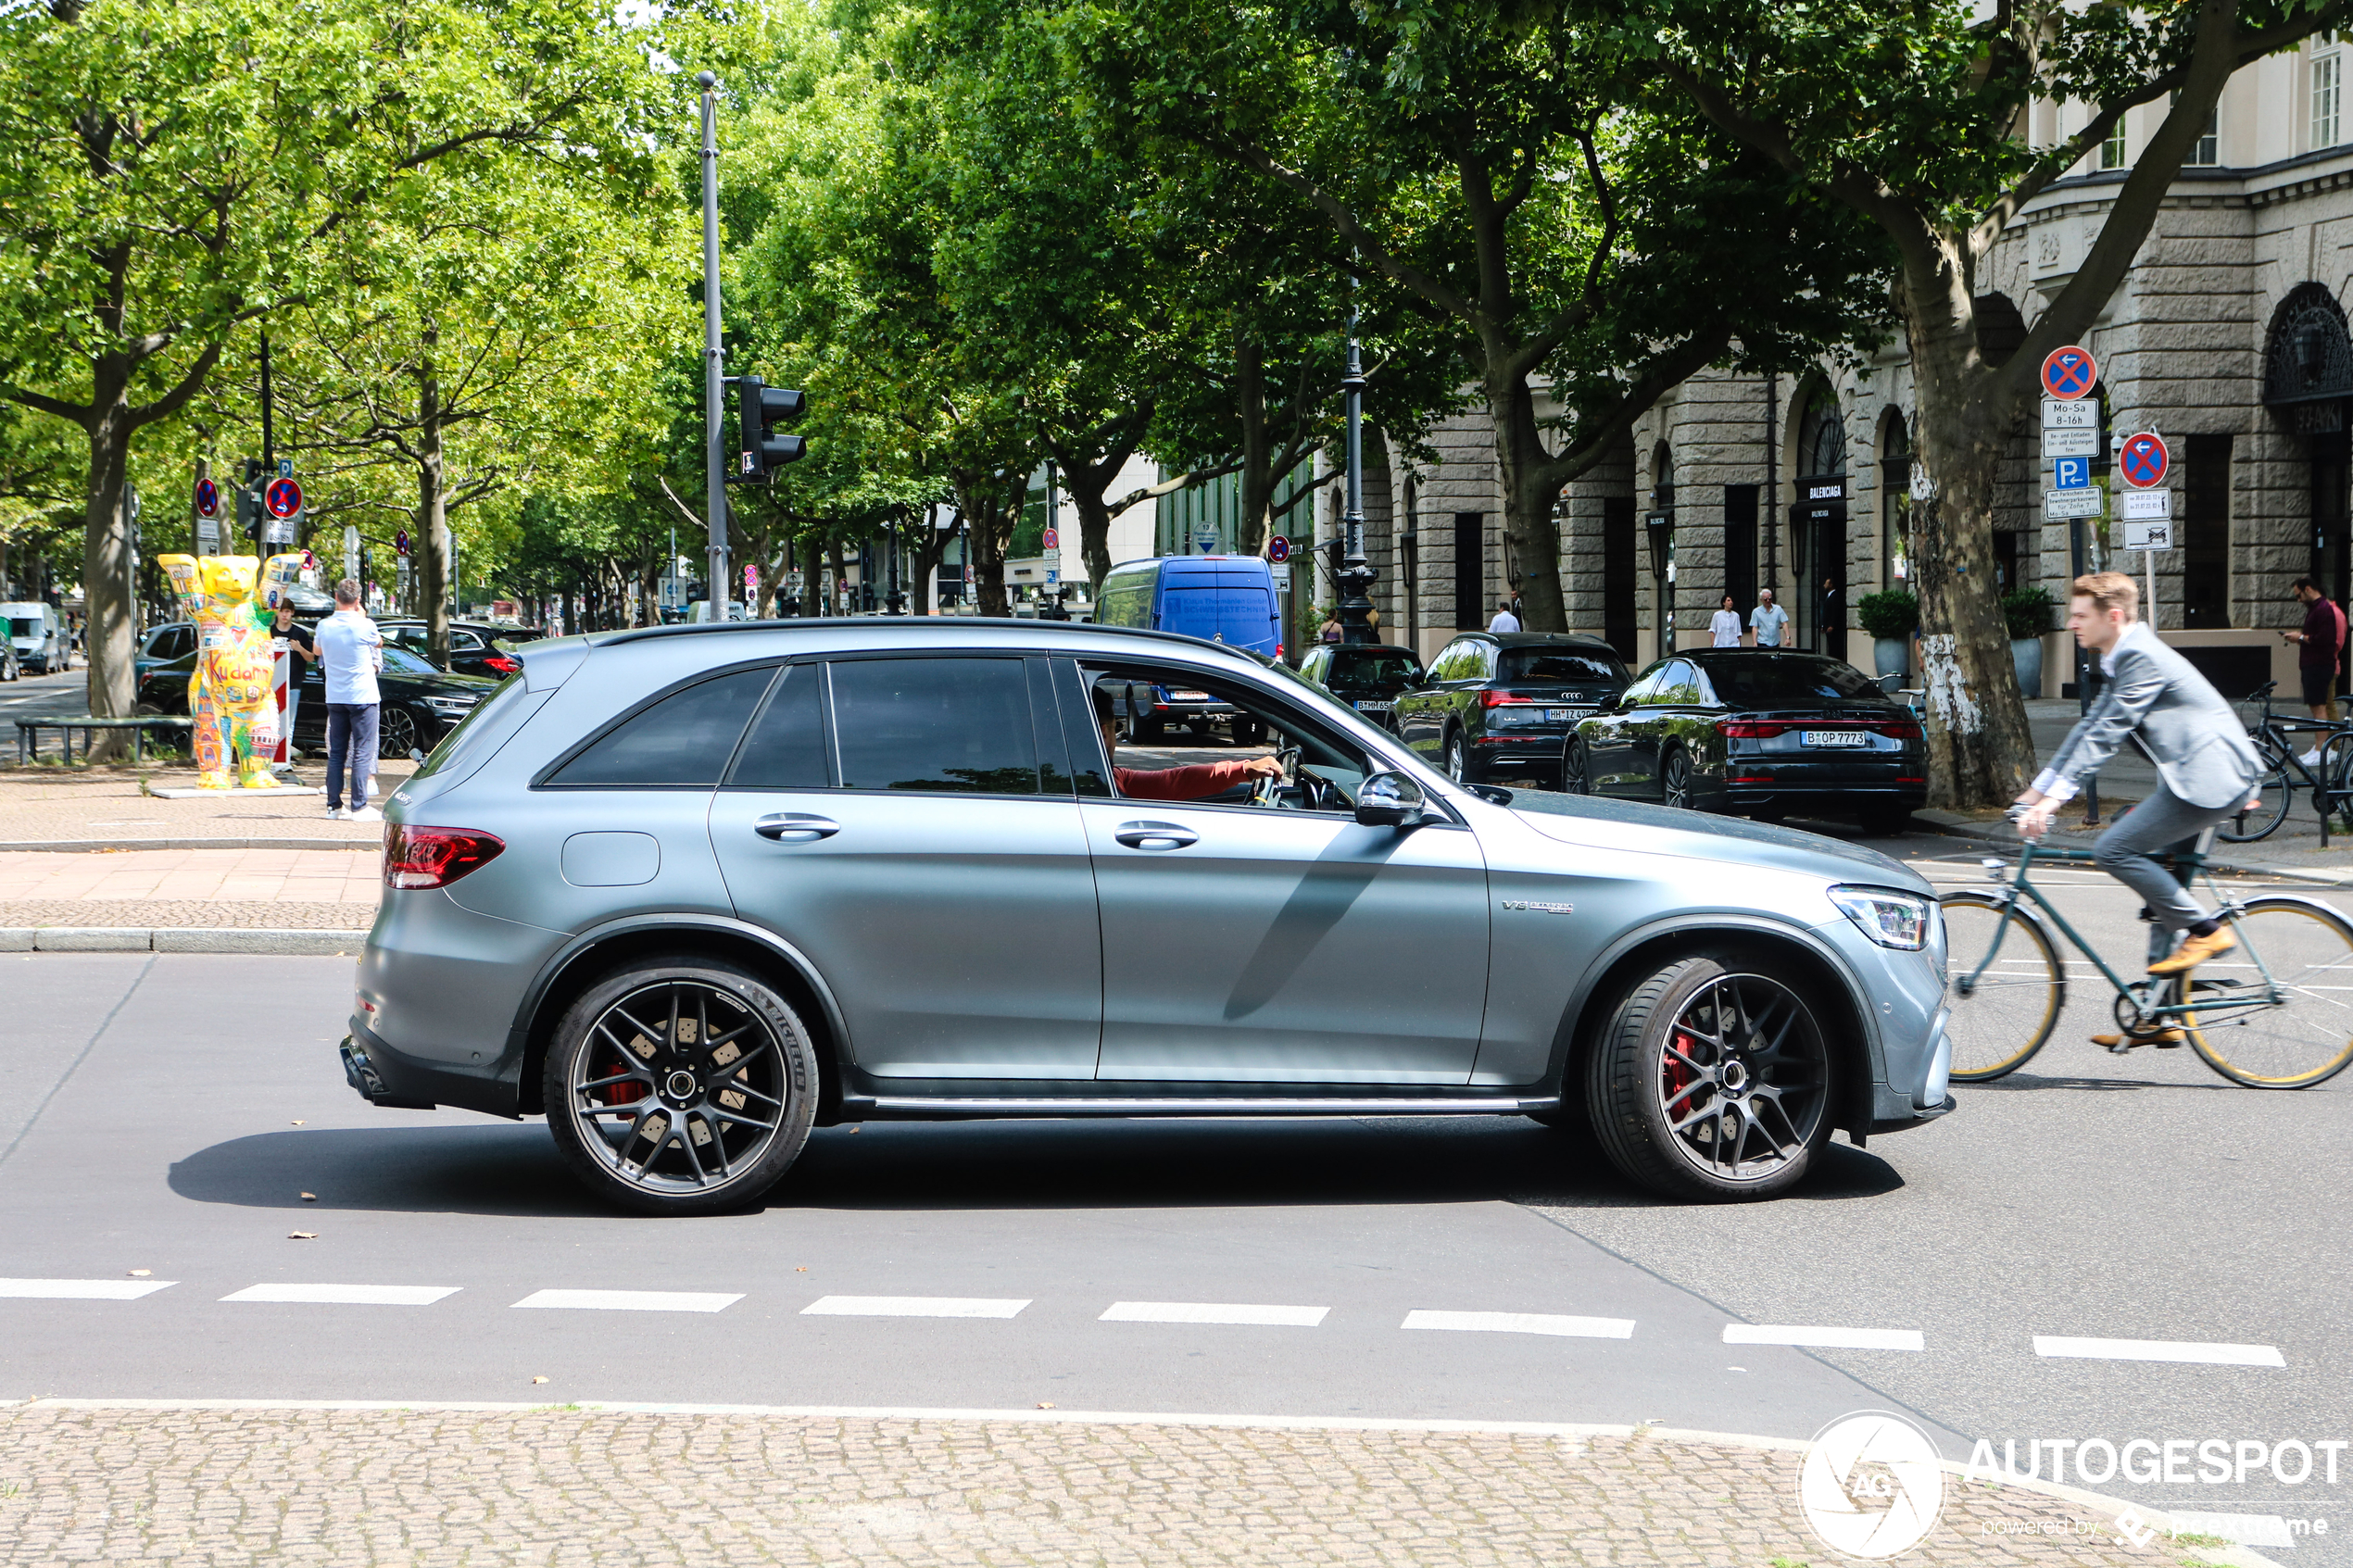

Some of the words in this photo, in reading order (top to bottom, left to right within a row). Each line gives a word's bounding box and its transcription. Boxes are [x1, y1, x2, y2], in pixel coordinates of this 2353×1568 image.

[2054, 404, 2086, 413] Mo-Sa
[2057, 416, 2082, 425] 8-16h
[2060, 460, 2078, 486] P
[1809, 484, 1842, 500] BALENCIAGA
[1811, 509, 1830, 518] BALENCIAGA
[1358, 701, 1364, 709] B
[1550, 709, 1561, 721] HH
[1566, 709, 1576, 721] IZ
[1807, 733, 1815, 743] B
[1821, 733, 1836, 744] OP
[1838, 733, 1864, 744] 7773
[768, 1005, 805, 1089] MICHELIN
